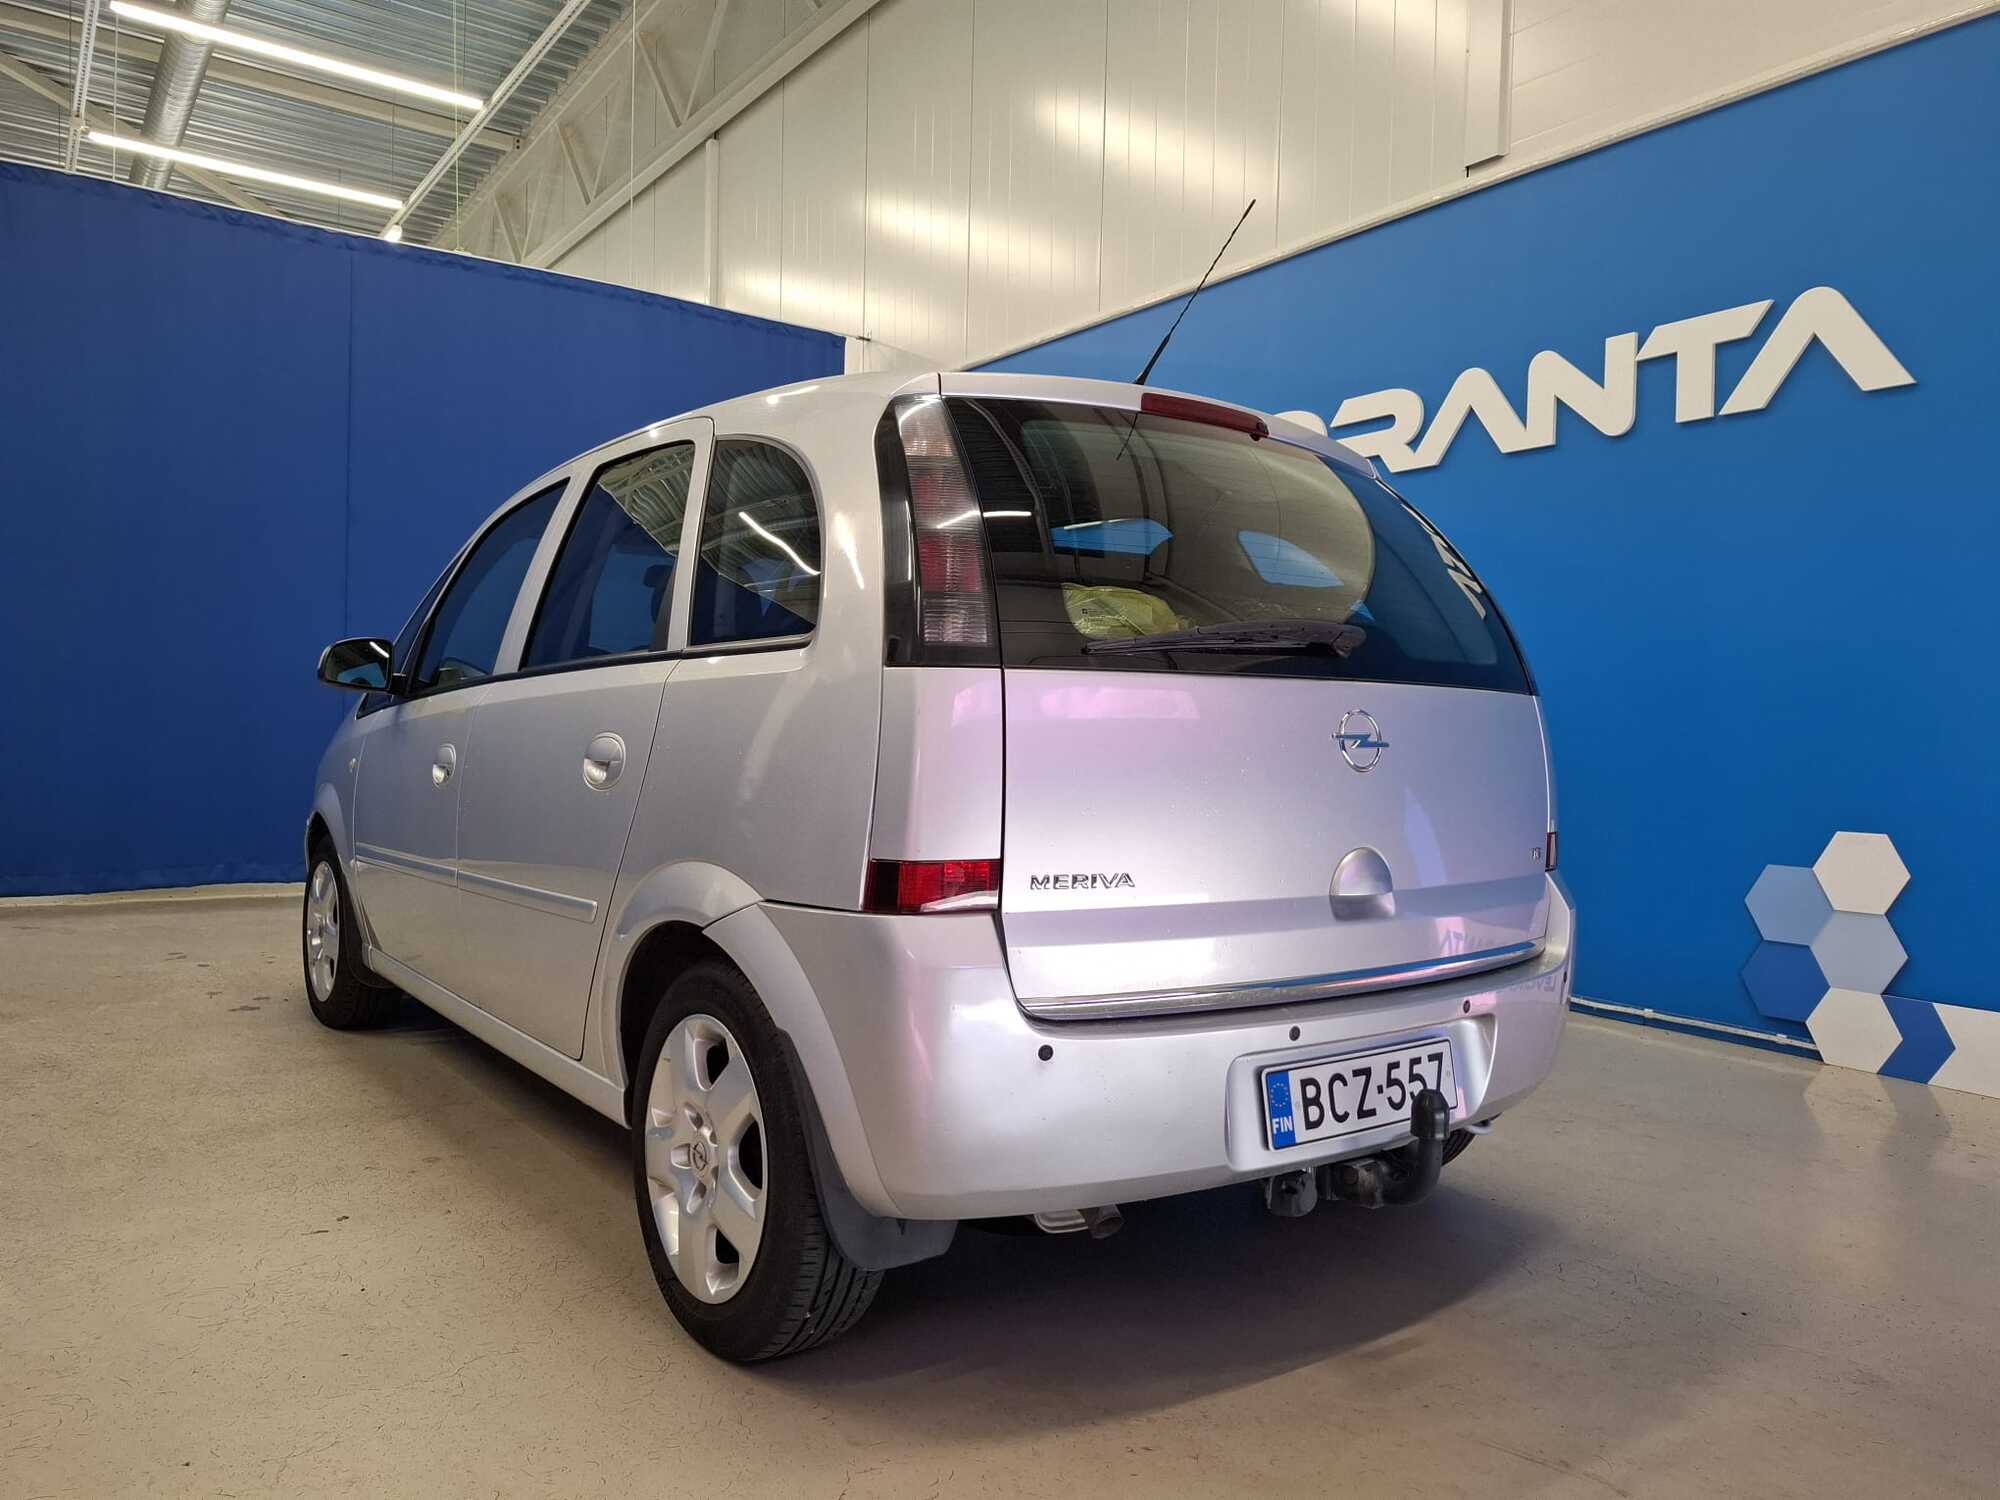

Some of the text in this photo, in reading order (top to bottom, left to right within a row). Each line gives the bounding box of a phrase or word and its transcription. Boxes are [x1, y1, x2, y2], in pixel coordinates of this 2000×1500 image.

[1273, 286, 1916, 472] RANTA
[1030, 872, 1136, 890] MERIVA
[1272, 1115, 1293, 1134] FIN
